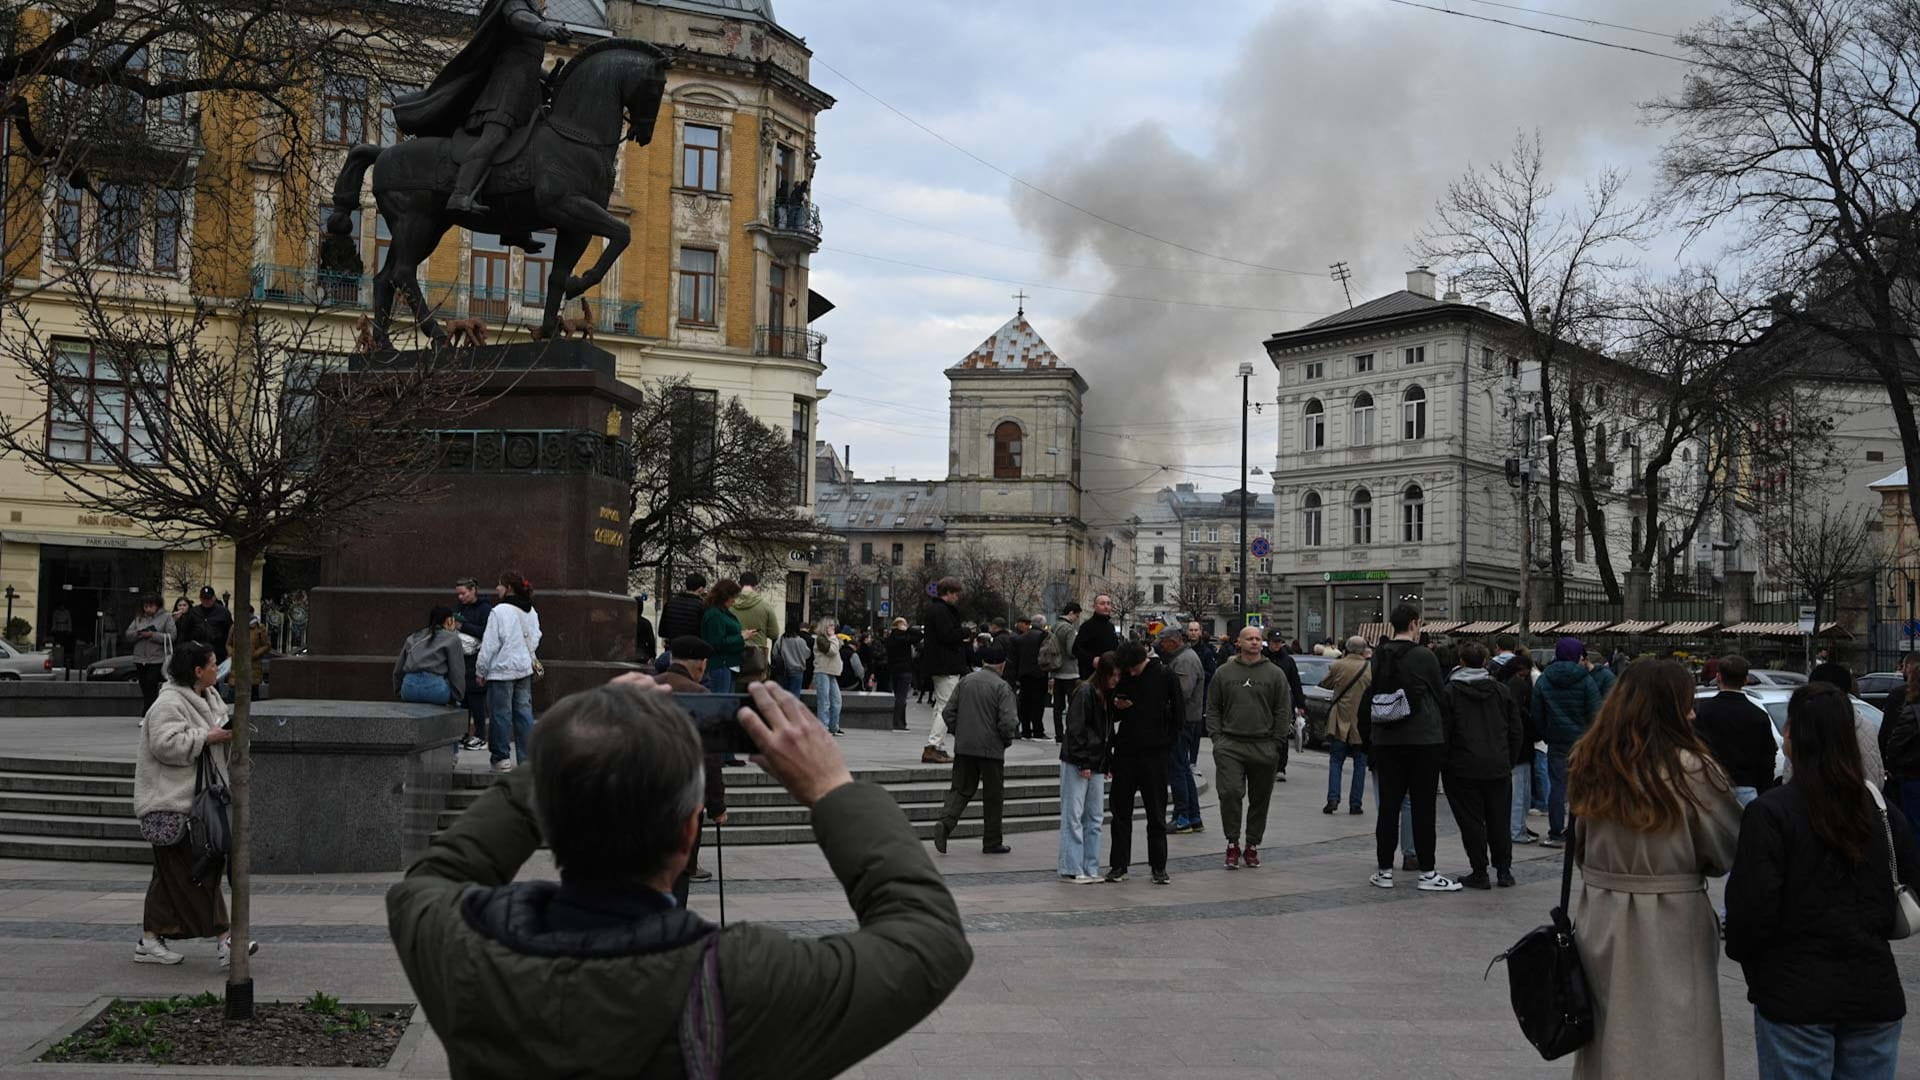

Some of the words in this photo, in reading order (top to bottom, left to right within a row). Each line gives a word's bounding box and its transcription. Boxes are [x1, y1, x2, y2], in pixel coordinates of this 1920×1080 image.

[78, 514, 100, 526] PARK
[86, 537, 102, 545] PARK
[103, 538, 128, 547] AVENUE
